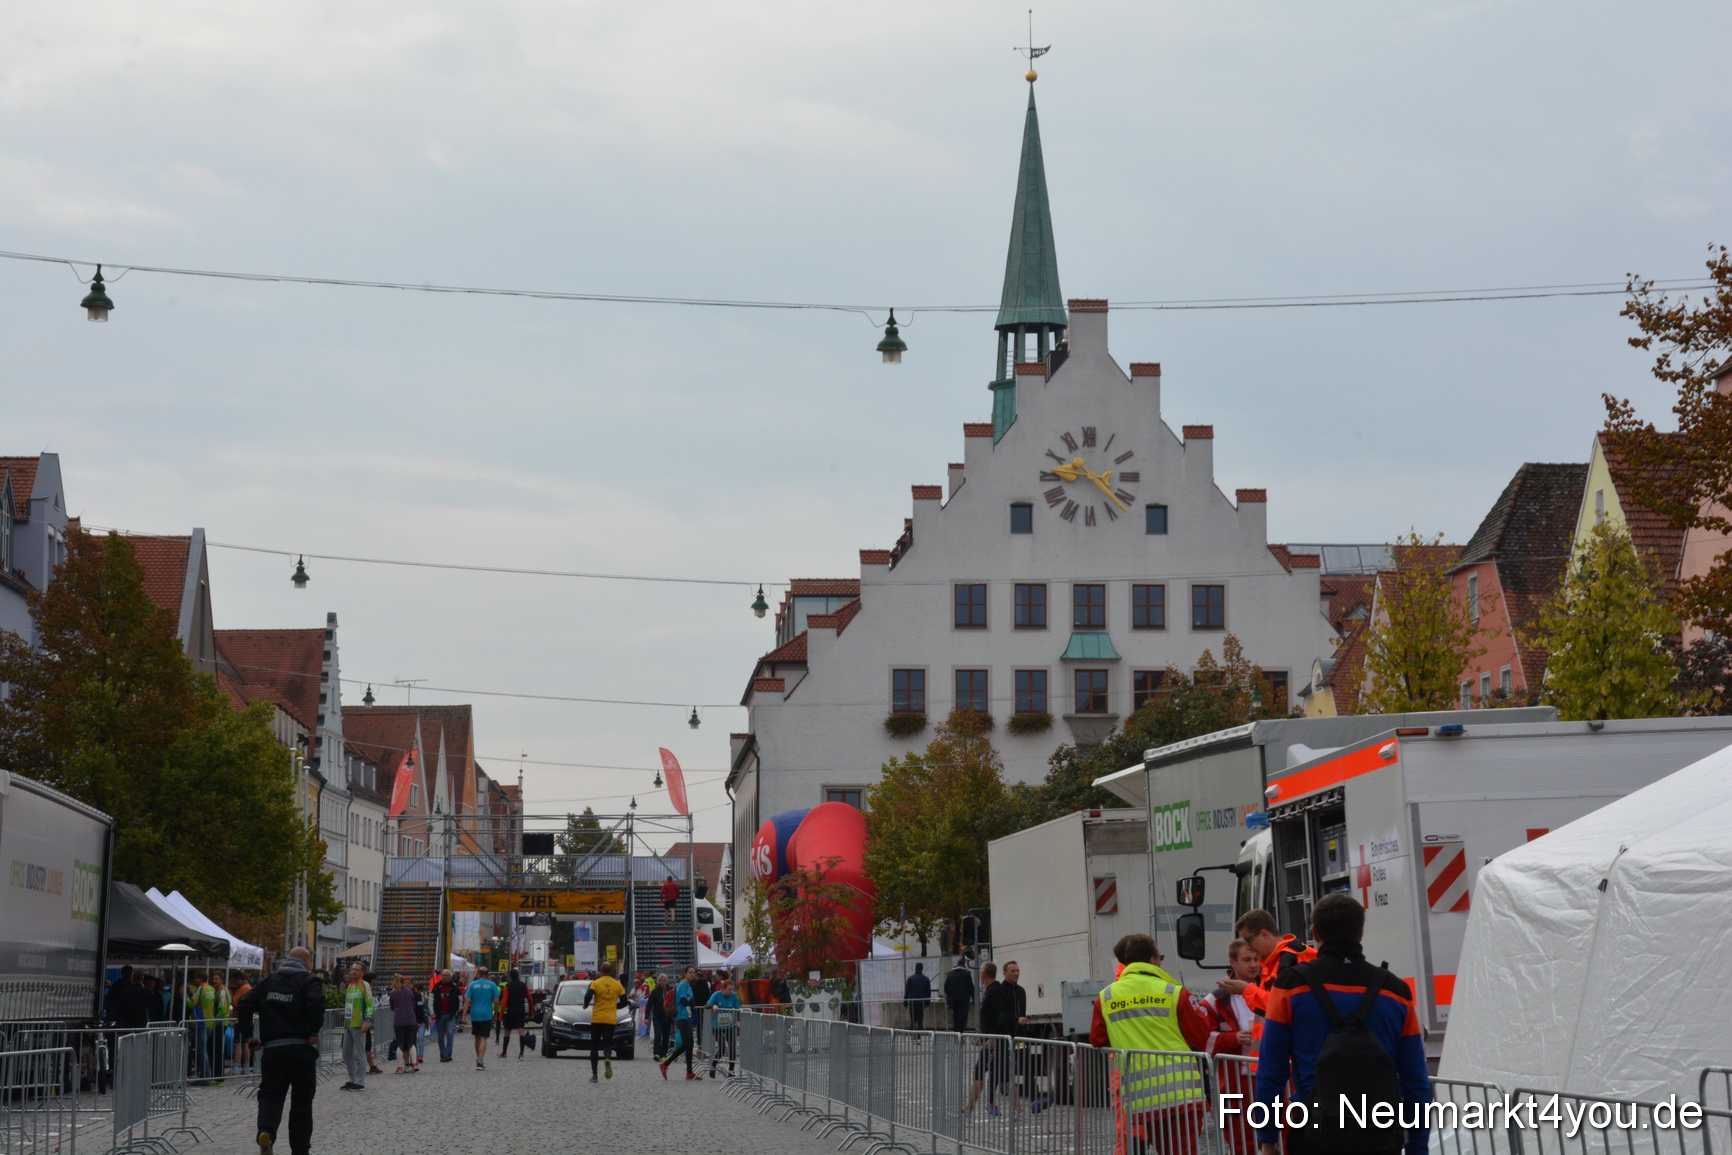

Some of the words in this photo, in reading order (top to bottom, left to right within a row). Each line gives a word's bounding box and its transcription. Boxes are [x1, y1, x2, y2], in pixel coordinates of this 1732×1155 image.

[1155, 806, 1191, 848] BOCK
[1196, 810, 1212, 831] OFFICE
[1213, 807, 1236, 830] INDUSTRY
[1371, 838, 1399, 860] Bayerisches
[1373, 866, 1386, 881] Rotes
[519, 895, 558, 909] ZIEL
[1375, 891, 1388, 907] Kreuz
[266, 991, 294, 1003] SECURITY
[1110, 995, 1166, 1010] Org.-Leiter
